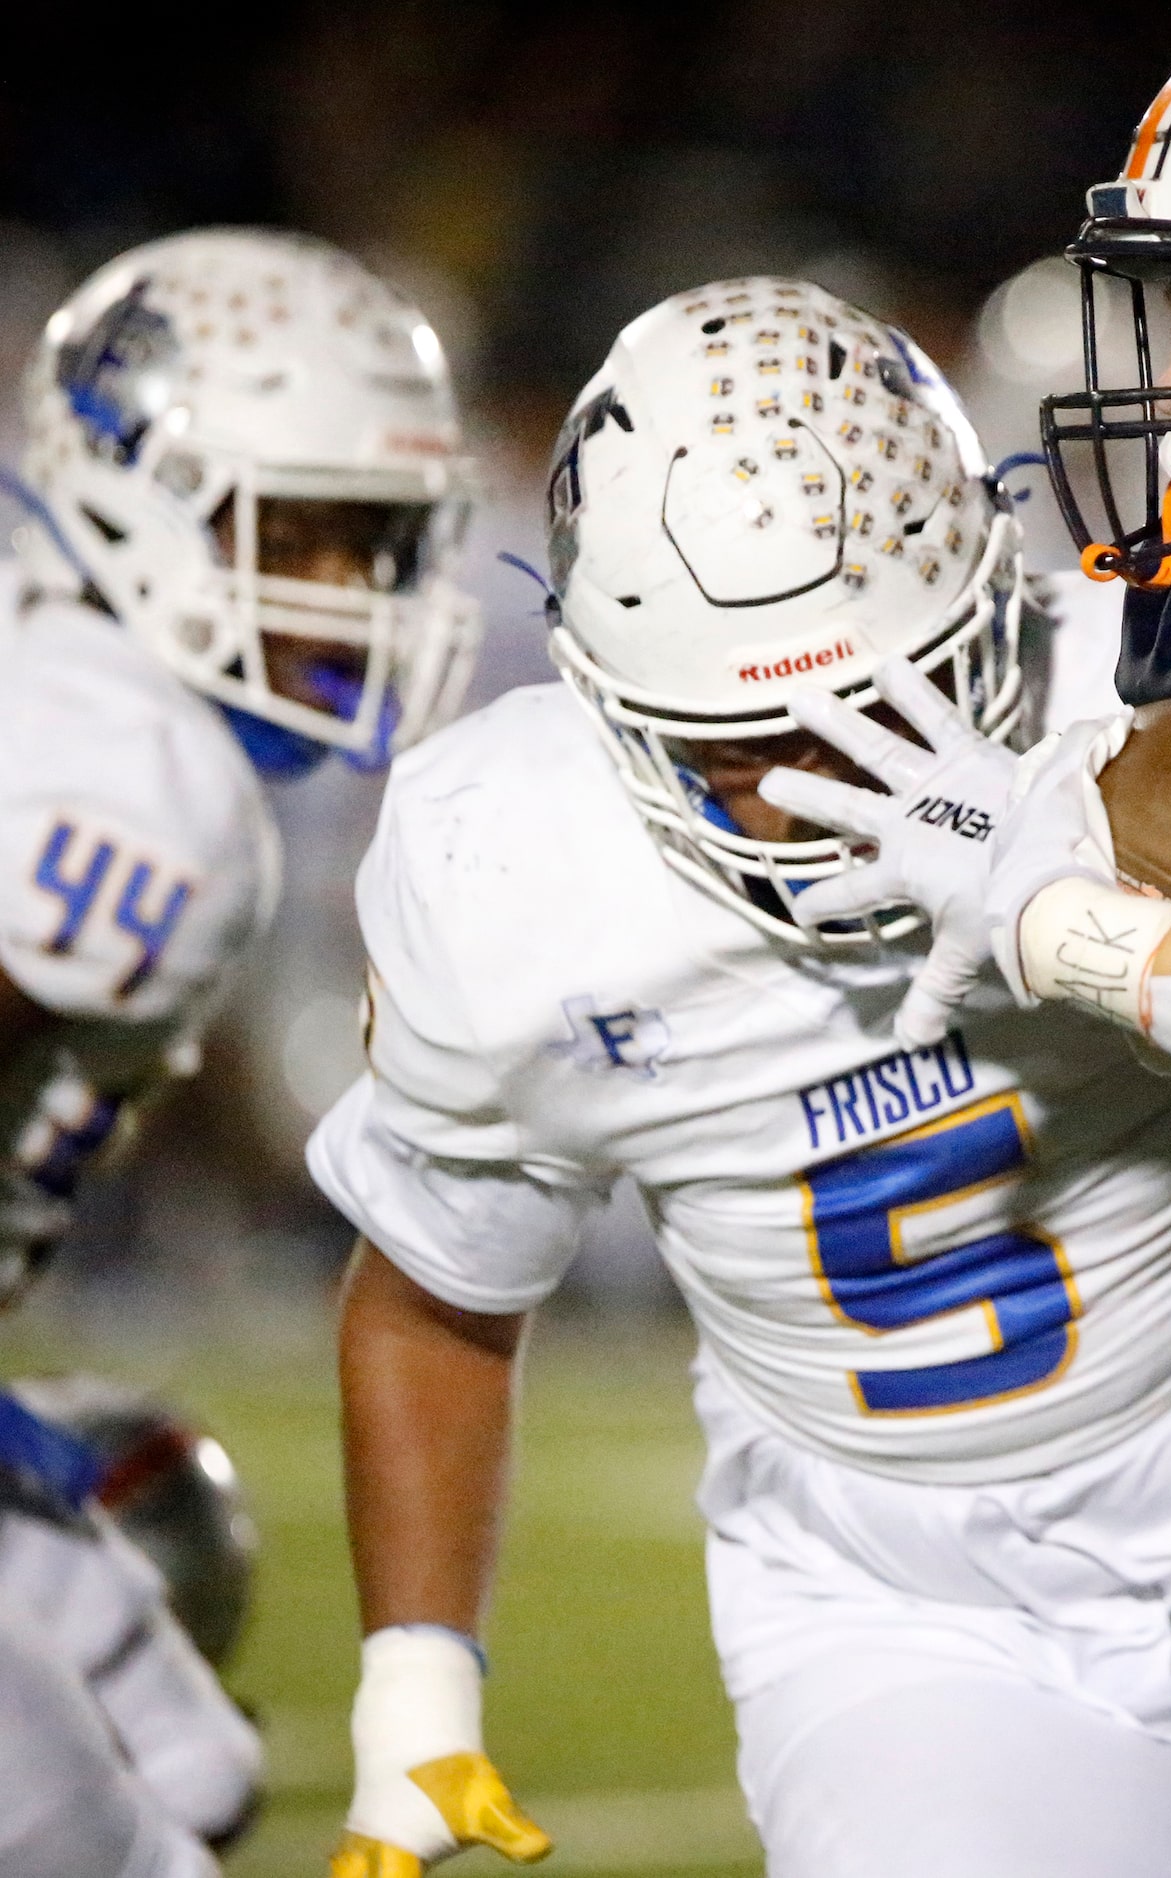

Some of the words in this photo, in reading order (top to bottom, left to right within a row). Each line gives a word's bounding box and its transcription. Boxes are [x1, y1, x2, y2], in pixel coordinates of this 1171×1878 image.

[738, 638, 855, 682] Riddell
[33, 819, 194, 1003] 44
[797, 1028, 976, 1149] FRISCO
[797, 1089, 1084, 1420] 5
